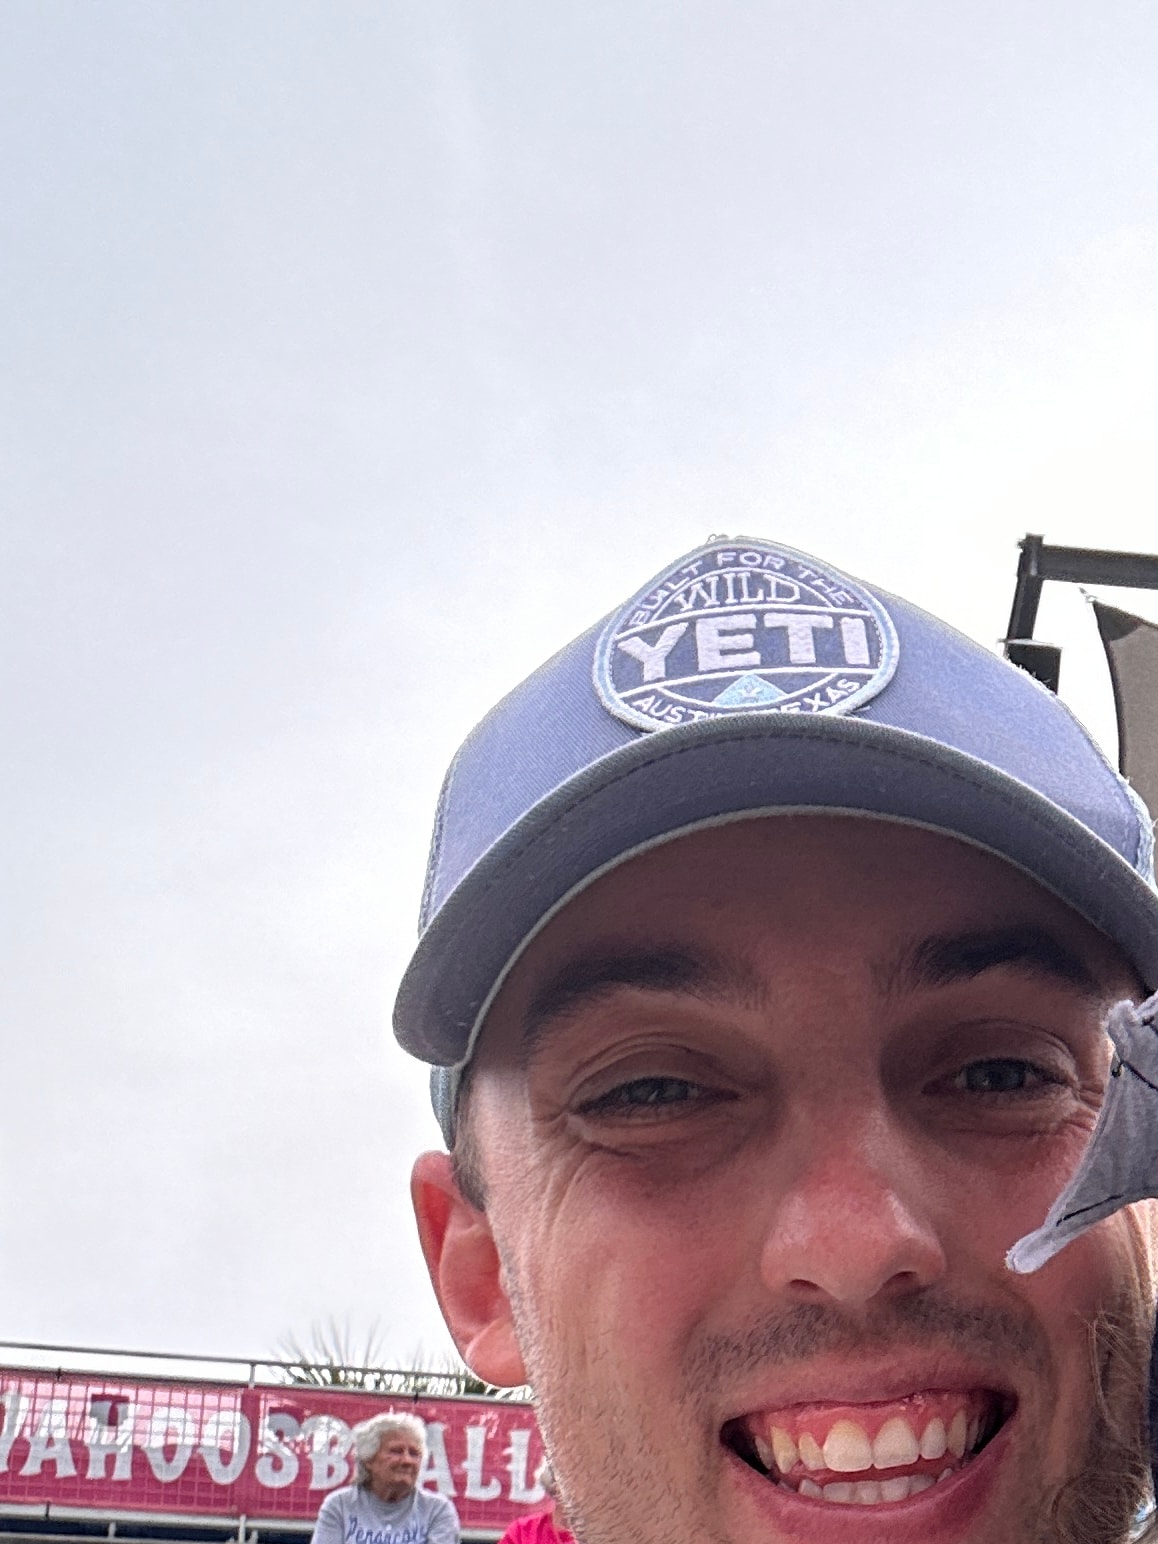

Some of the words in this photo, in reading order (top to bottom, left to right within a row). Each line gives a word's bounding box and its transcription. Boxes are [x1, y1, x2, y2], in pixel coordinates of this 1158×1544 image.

[628, 560, 703, 626] BUILT
[716, 550, 786, 571] FOR
[797, 565, 855, 606] THE
[673, 570, 801, 613] WILD
[617, 612, 871, 682] YETI
[768, 678, 861, 712] EXAS
